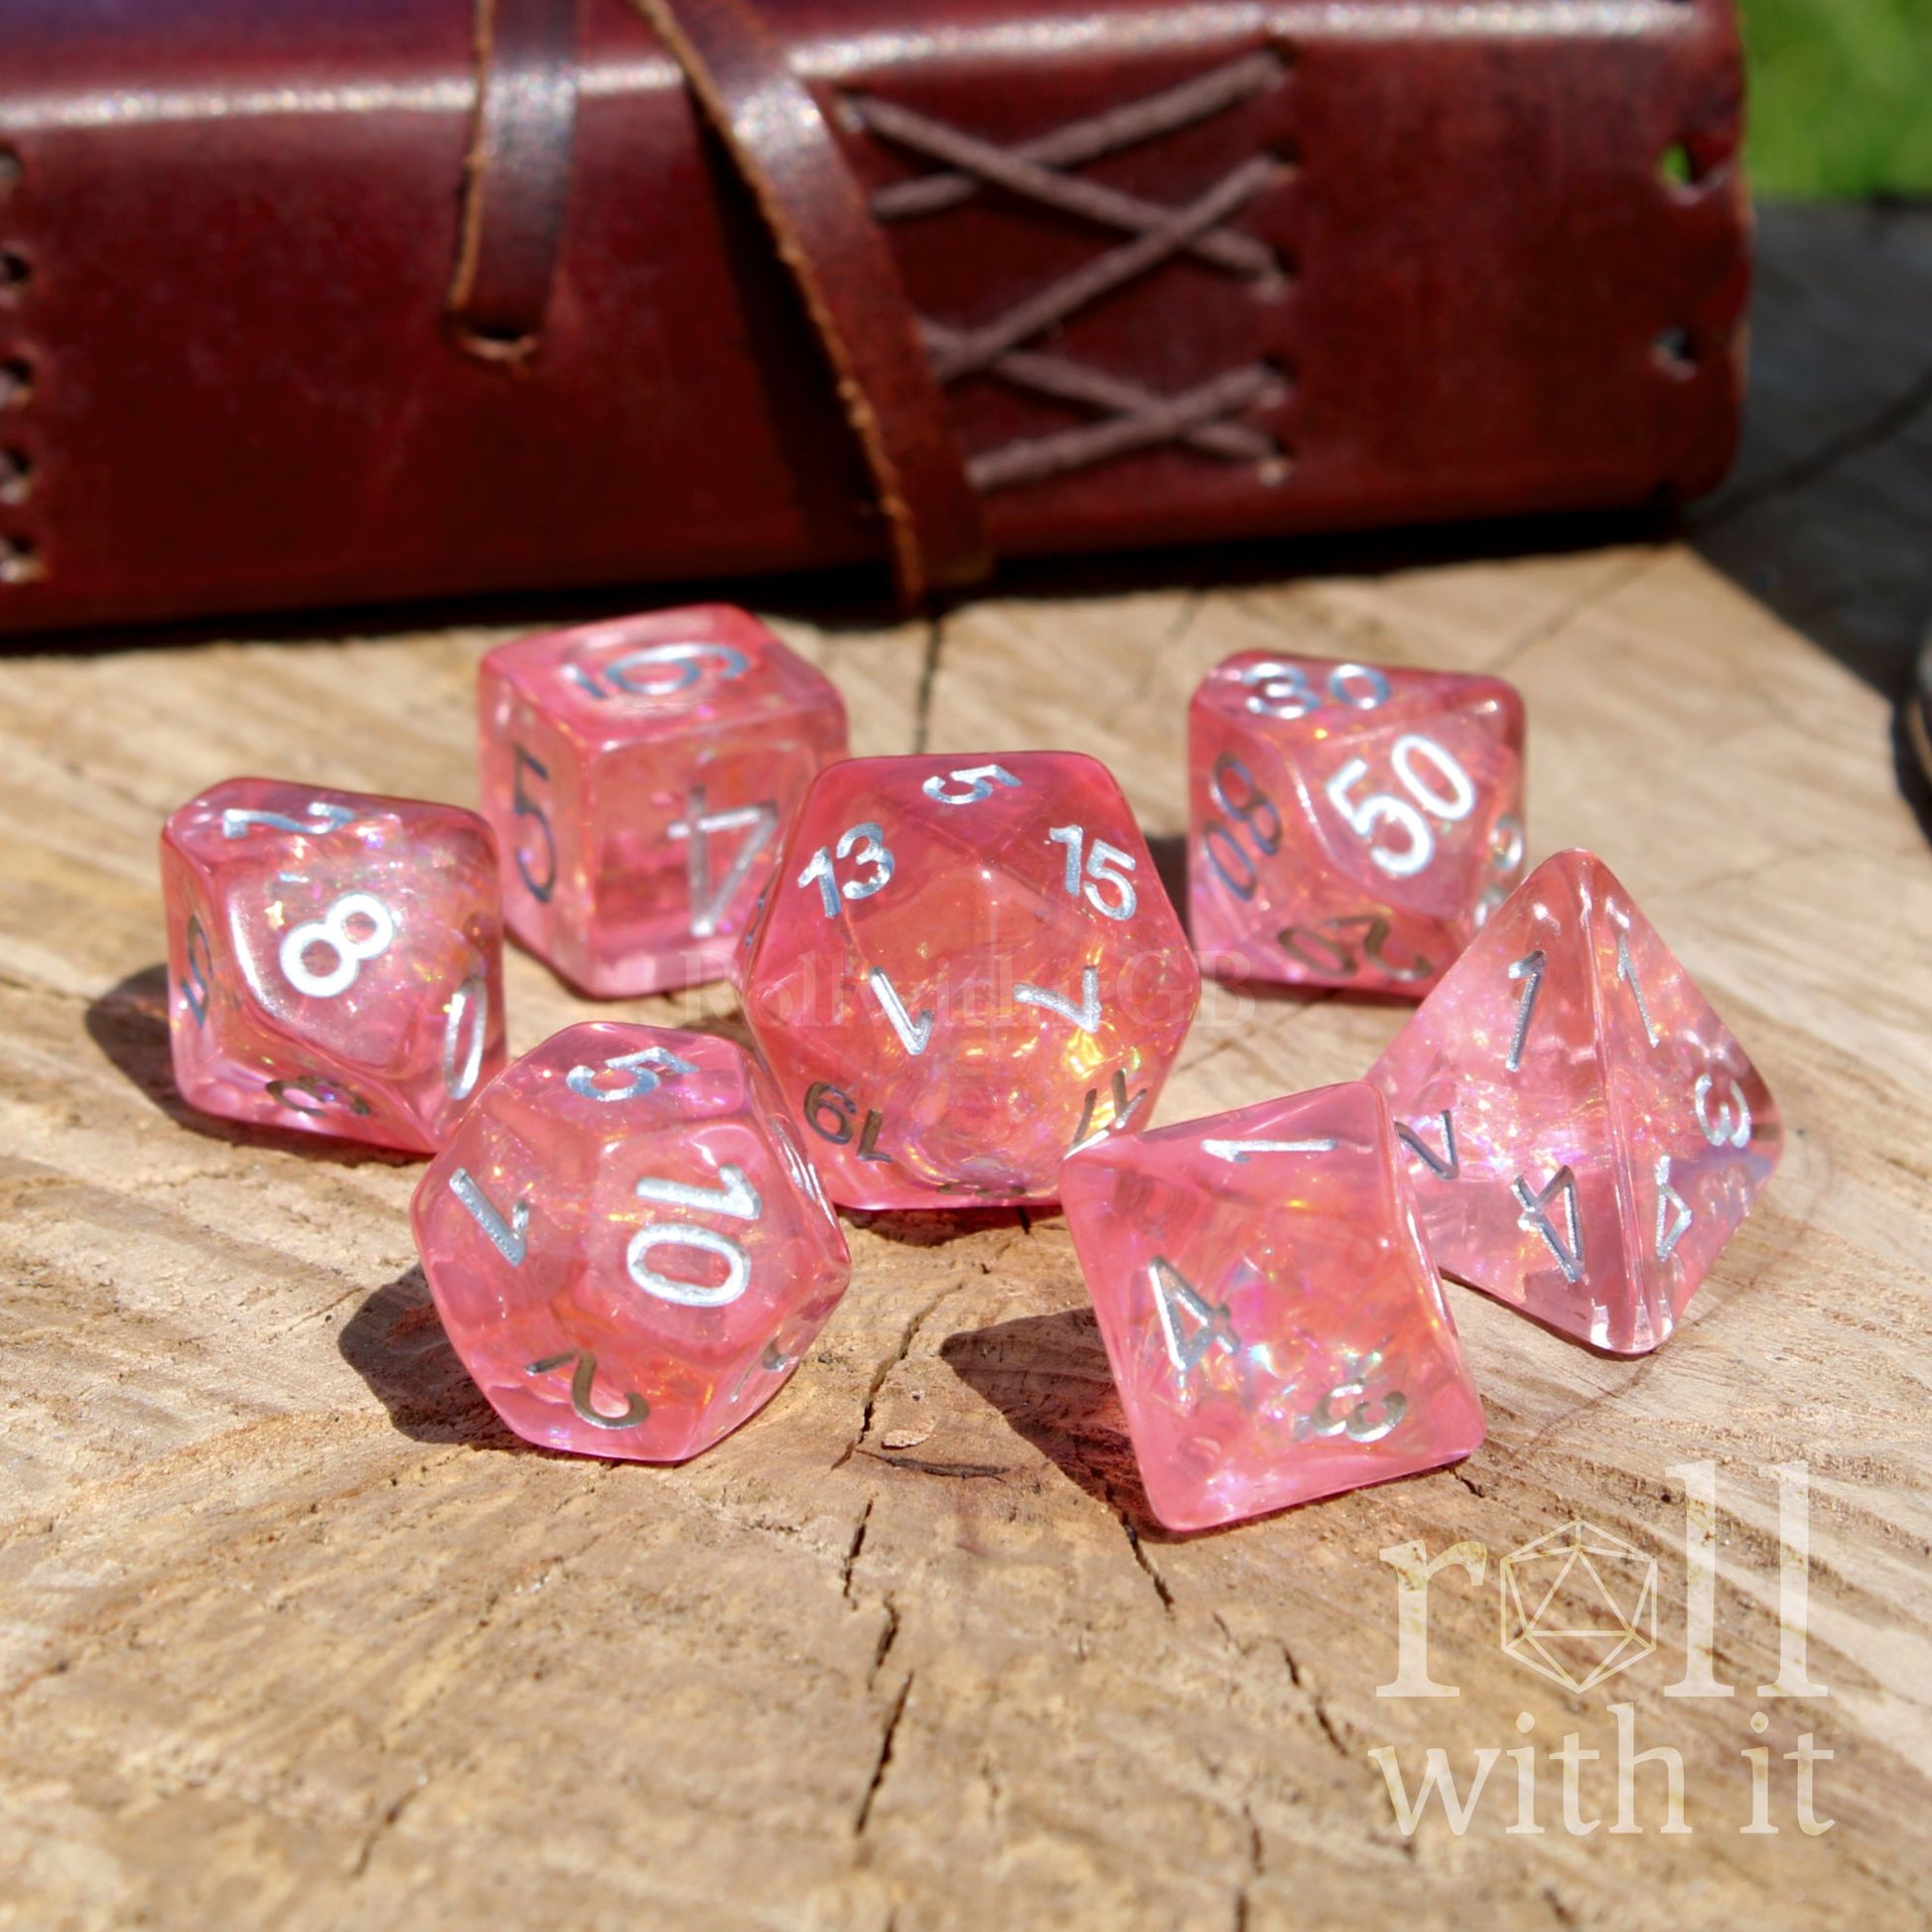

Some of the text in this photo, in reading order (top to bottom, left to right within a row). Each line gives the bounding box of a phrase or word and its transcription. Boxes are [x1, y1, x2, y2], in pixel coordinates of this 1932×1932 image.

[1242, 661, 1394, 720] 30
[510, 743, 558, 904] 5
[922, 763, 1024, 805] 5
[1325, 734, 1476, 877] 50
[667, 784, 779, 936] 4
[797, 822, 894, 917] 13
[1048, 824, 1138, 921] 15
[278, 894, 395, 999] 8
[1616, 931, 1659, 1046] 1
[1507, 949, 1547, 1072] 1
[1200, 1139, 1339, 1165] 1
[1694, 1073, 1751, 1148] 3
[625, 1163, 762, 1308] 10
[1510, 1164, 1586, 1284] 4
[1147, 1254, 1243, 1372] 4
